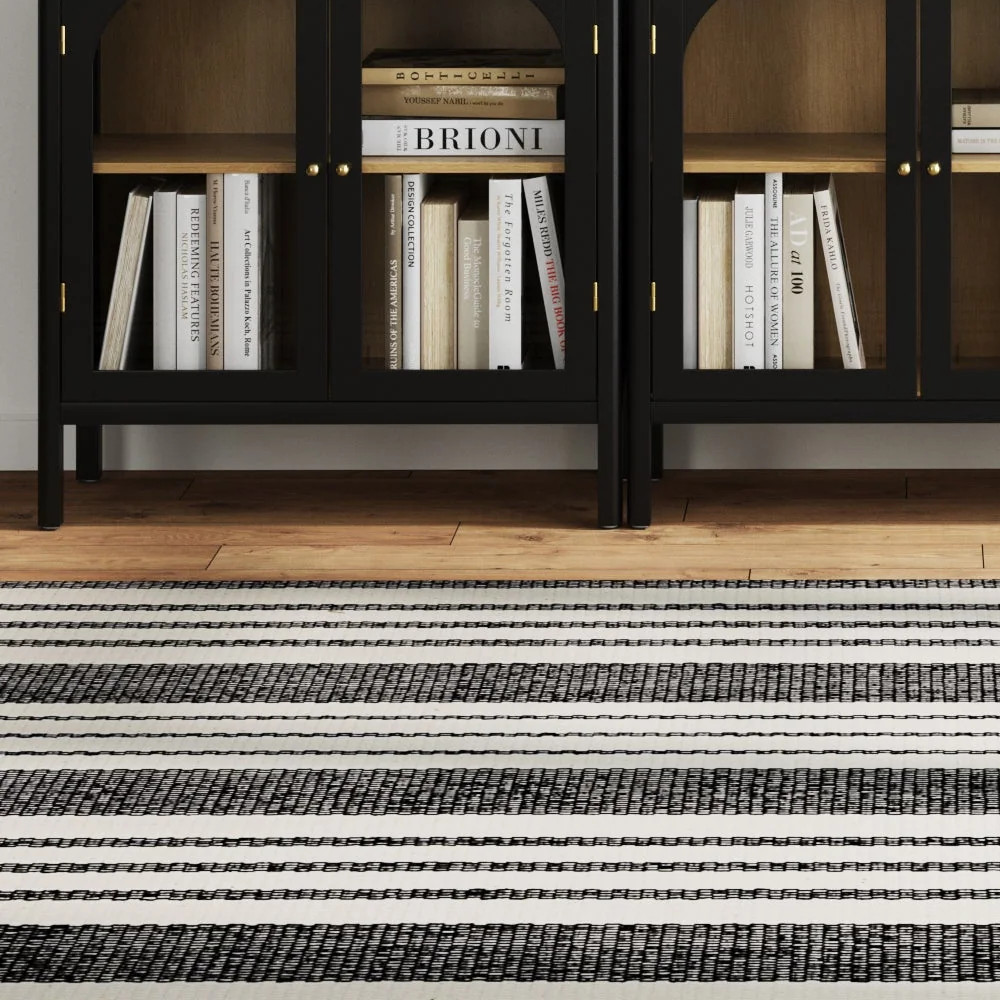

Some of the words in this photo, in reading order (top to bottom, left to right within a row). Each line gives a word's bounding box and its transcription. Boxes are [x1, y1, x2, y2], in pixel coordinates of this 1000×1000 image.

[396, 71, 535, 81] BOTTICELLI
[404, 96, 441, 105] YOUSSEF
[413, 127, 544, 151] BRIONI
[407, 181, 415, 213] DESIGN
[503, 193, 514, 215] The
[532, 189, 546, 224] MILES
[744, 206, 755, 229] JULIE
[769, 217, 779, 238] THE
[789, 211, 809, 247] AD
[190, 207, 201, 278] REDEEMING
[243, 230, 252, 241] Art
[407, 214, 415, 268] COLLECTION
[473, 238, 482, 254] The
[538, 227, 553, 258] REDD
[744, 230, 755, 269] GARWOOD
[820, 204, 832, 235] FRIDA
[826, 236, 838, 271] KAHLO
[180, 231, 190, 280] NICHOLAS
[209, 240, 221, 281] HAUTE
[243, 242, 252, 279] Collections
[503, 220, 514, 283] Forgotten
[769, 239, 779, 285] ALLURE
[243, 280, 252, 288] in
[389, 259, 398, 309] AMERICAS
[463, 263, 472, 299] Business
[473, 256, 482, 292] Monocle
[545, 258, 557, 283] THE
[790, 272, 804, 295] 100
[180, 282, 190, 320] HASLAM
[243, 289, 252, 315] Palazzo
[473, 292, 482, 318] Guide
[503, 289, 514, 323] Room
[549, 285, 561, 305] BIG
[769, 286, 779, 300] OF
[190, 282, 201, 343] FEATURES
[209, 284, 221, 357] BOHEMIANS
[243, 316, 252, 336] Koch,
[389, 309, 398, 325] THE
[473, 319, 482, 329] to
[553, 307, 566, 338] BOOK
[744, 284, 755, 348] HOTSHOT
[769, 303, 779, 347] WOMEN
[243, 337, 252, 358] Rome
[389, 329, 398, 341] OF
[389, 342, 398, 370] RUINS
